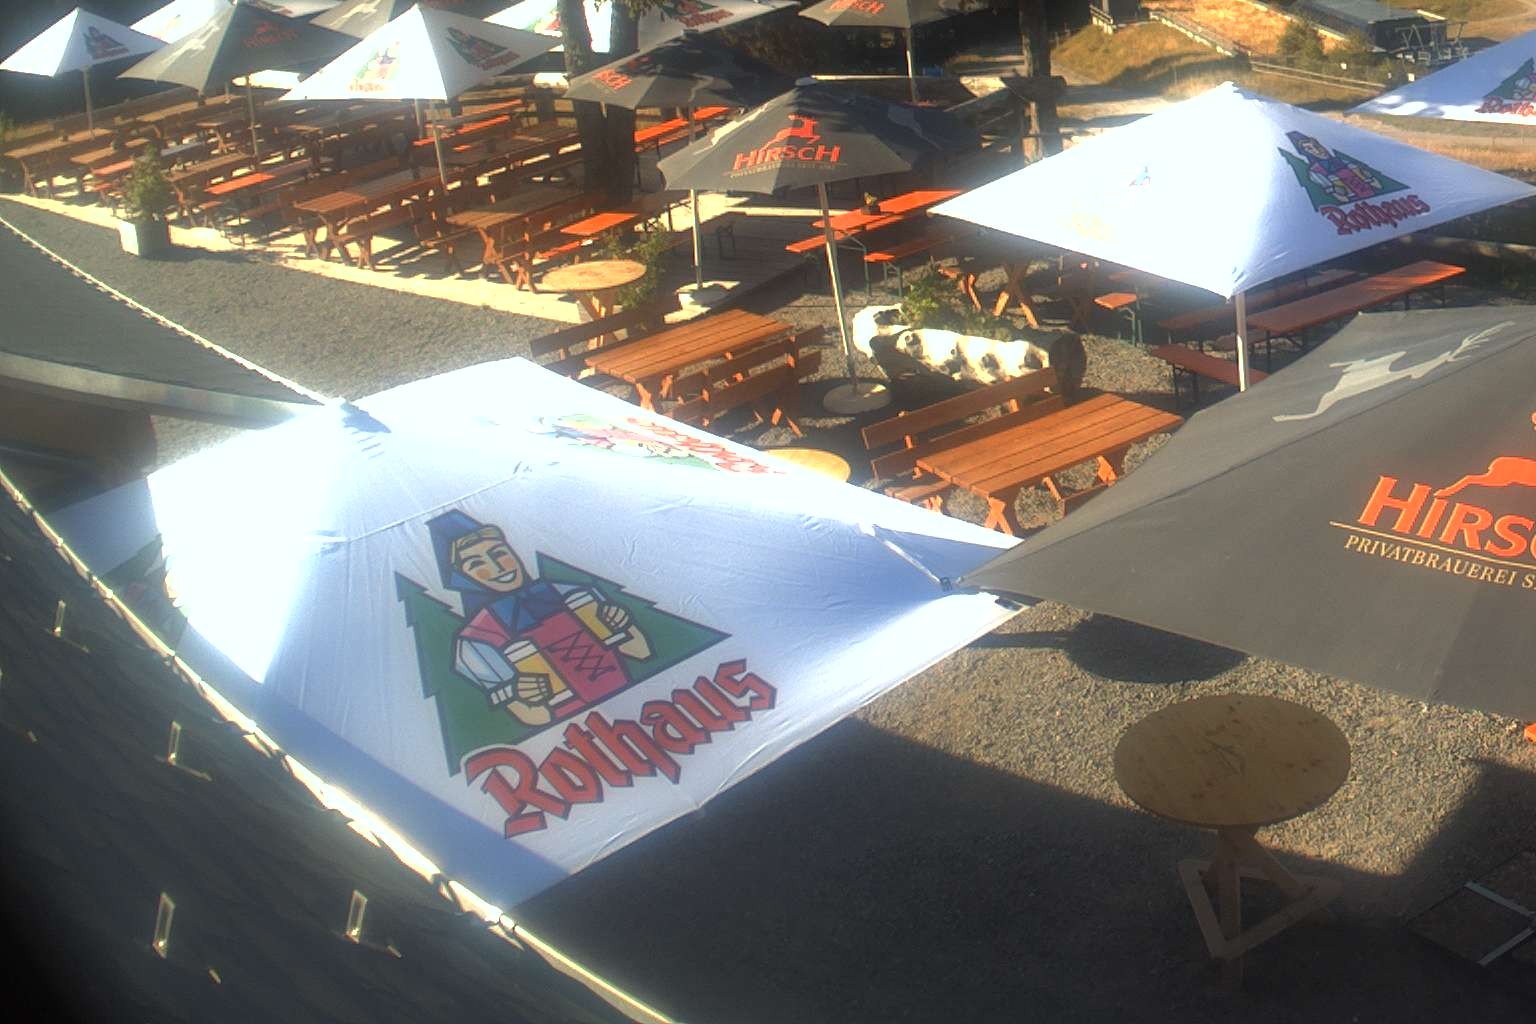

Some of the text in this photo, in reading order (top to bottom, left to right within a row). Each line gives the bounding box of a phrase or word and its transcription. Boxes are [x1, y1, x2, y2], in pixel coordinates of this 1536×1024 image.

[733, 144, 840, 170] HIRSCH
[1318, 193, 1431, 236] Rothaus
[1344, 534, 1517, 586] PRIVATBRAUEREI
[463, 658, 778, 839] Rothaus
